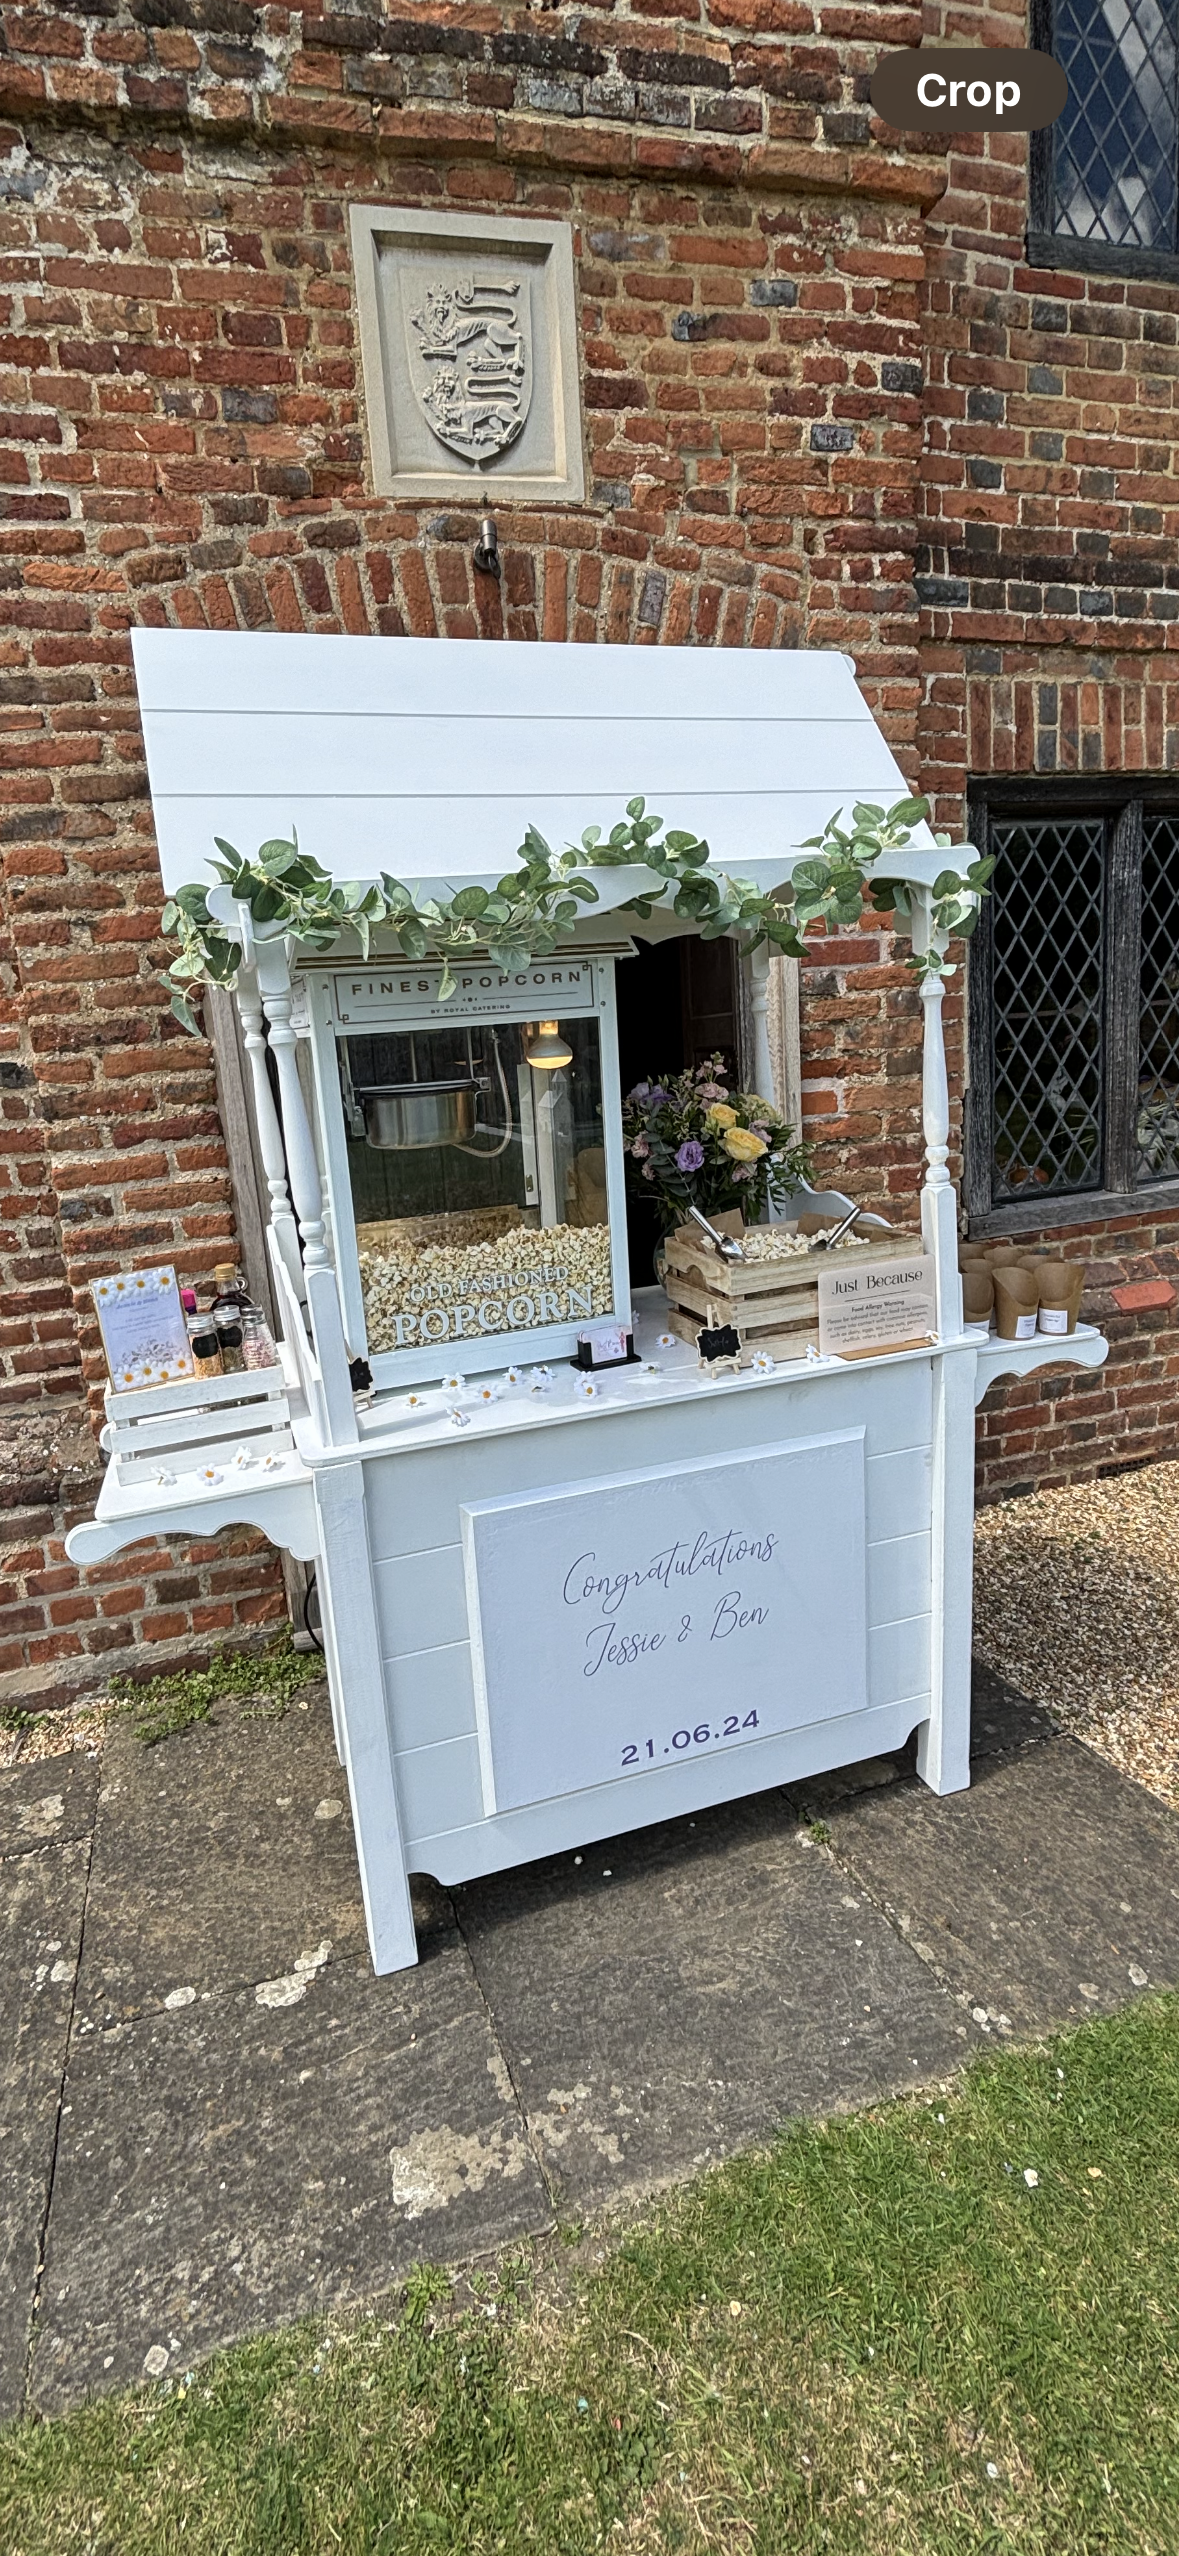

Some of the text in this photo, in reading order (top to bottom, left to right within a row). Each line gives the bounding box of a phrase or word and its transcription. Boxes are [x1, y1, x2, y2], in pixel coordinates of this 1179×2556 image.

[352, 970, 582, 996] FINES POPCORN
[472, 1004, 511, 1012] CATERING
[410, 1265, 569, 1302] OLD FASHIONED
[831, 1270, 923, 1295] Just Because
[391, 1285, 596, 1346] POPCORN
[563, 1529, 779, 1614] Congratulations
[583, 1591, 769, 1677] Jessie & Ben
[620, 1709, 760, 1767] 21.06.24
